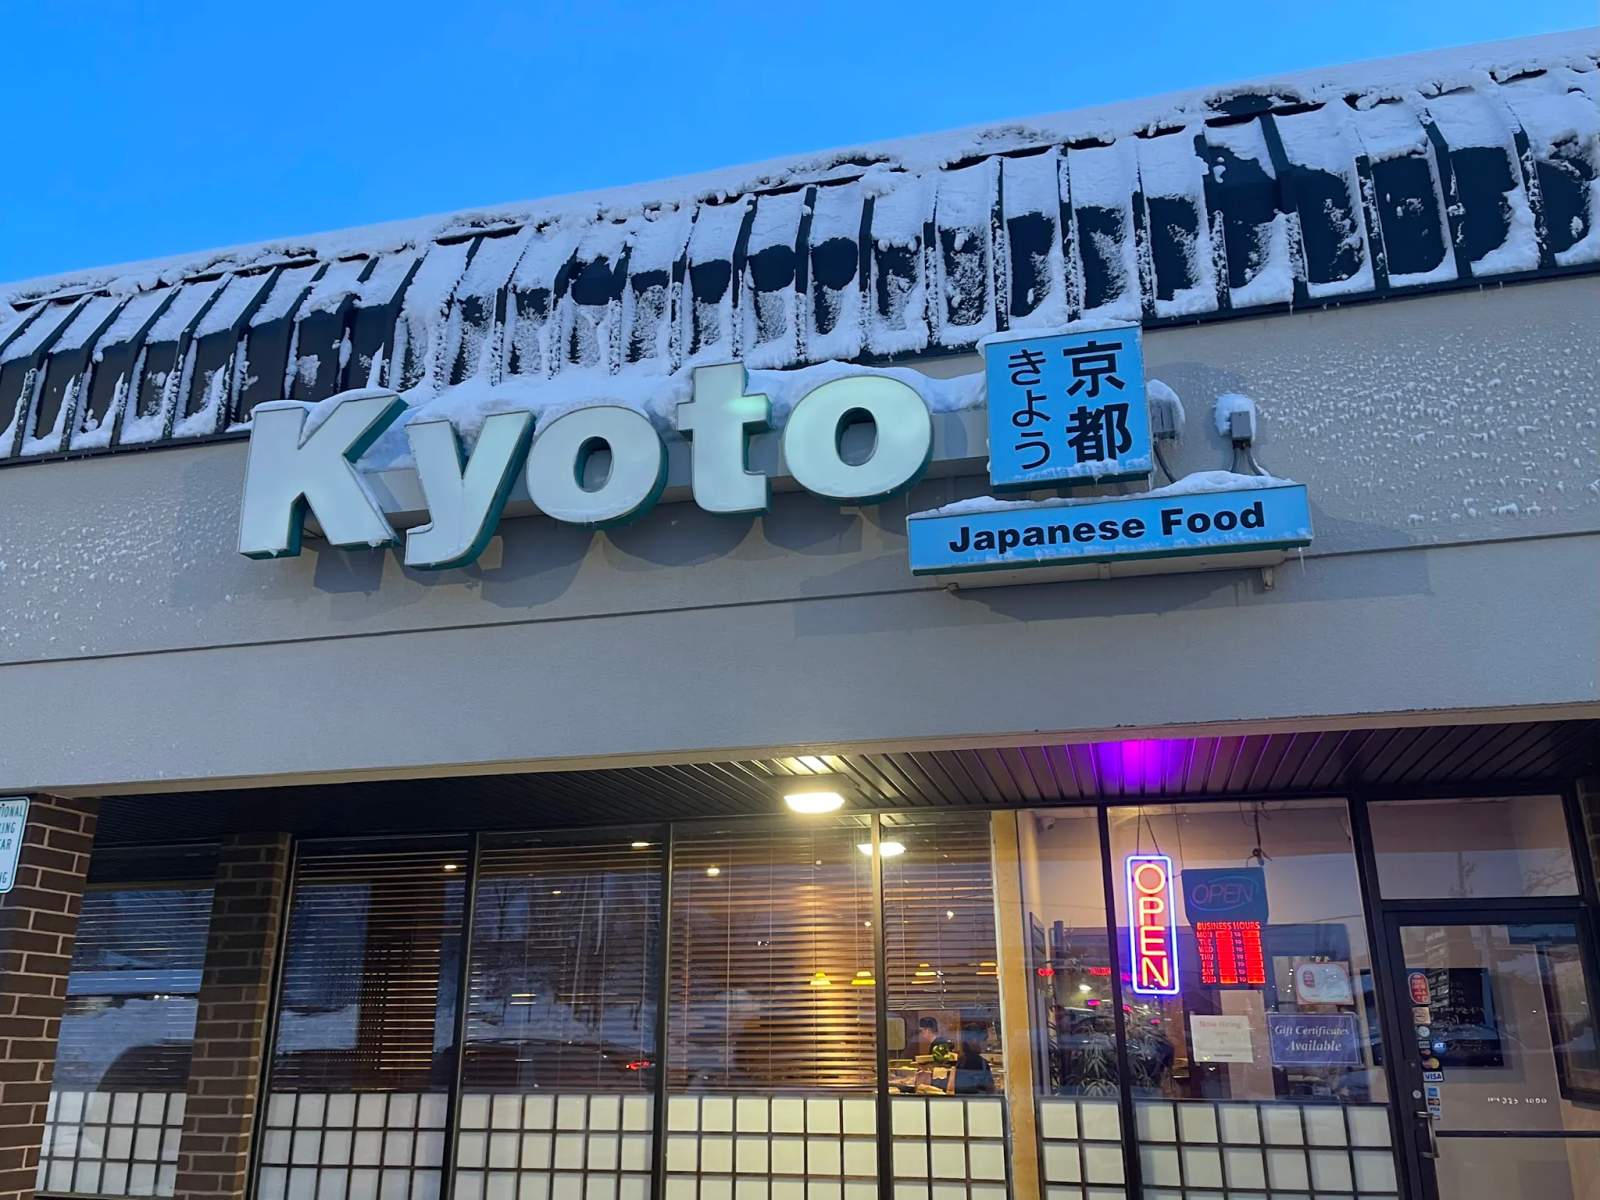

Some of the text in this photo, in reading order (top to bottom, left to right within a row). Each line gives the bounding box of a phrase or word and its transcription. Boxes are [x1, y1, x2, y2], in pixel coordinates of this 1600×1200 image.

[1063, 340, 1133, 461] 京都
[239, 363, 933, 567] Kyoto
[949, 501, 1266, 554] Japanese Food
[1192, 883, 1254, 904] OPEN
[1133, 863, 1169, 987] OPEN
[1196, 921, 1261, 930] BUSINESS HOURS
[1274, 1025, 1349, 1037] Gift Certificates
[1286, 1040, 1342, 1052] Available
